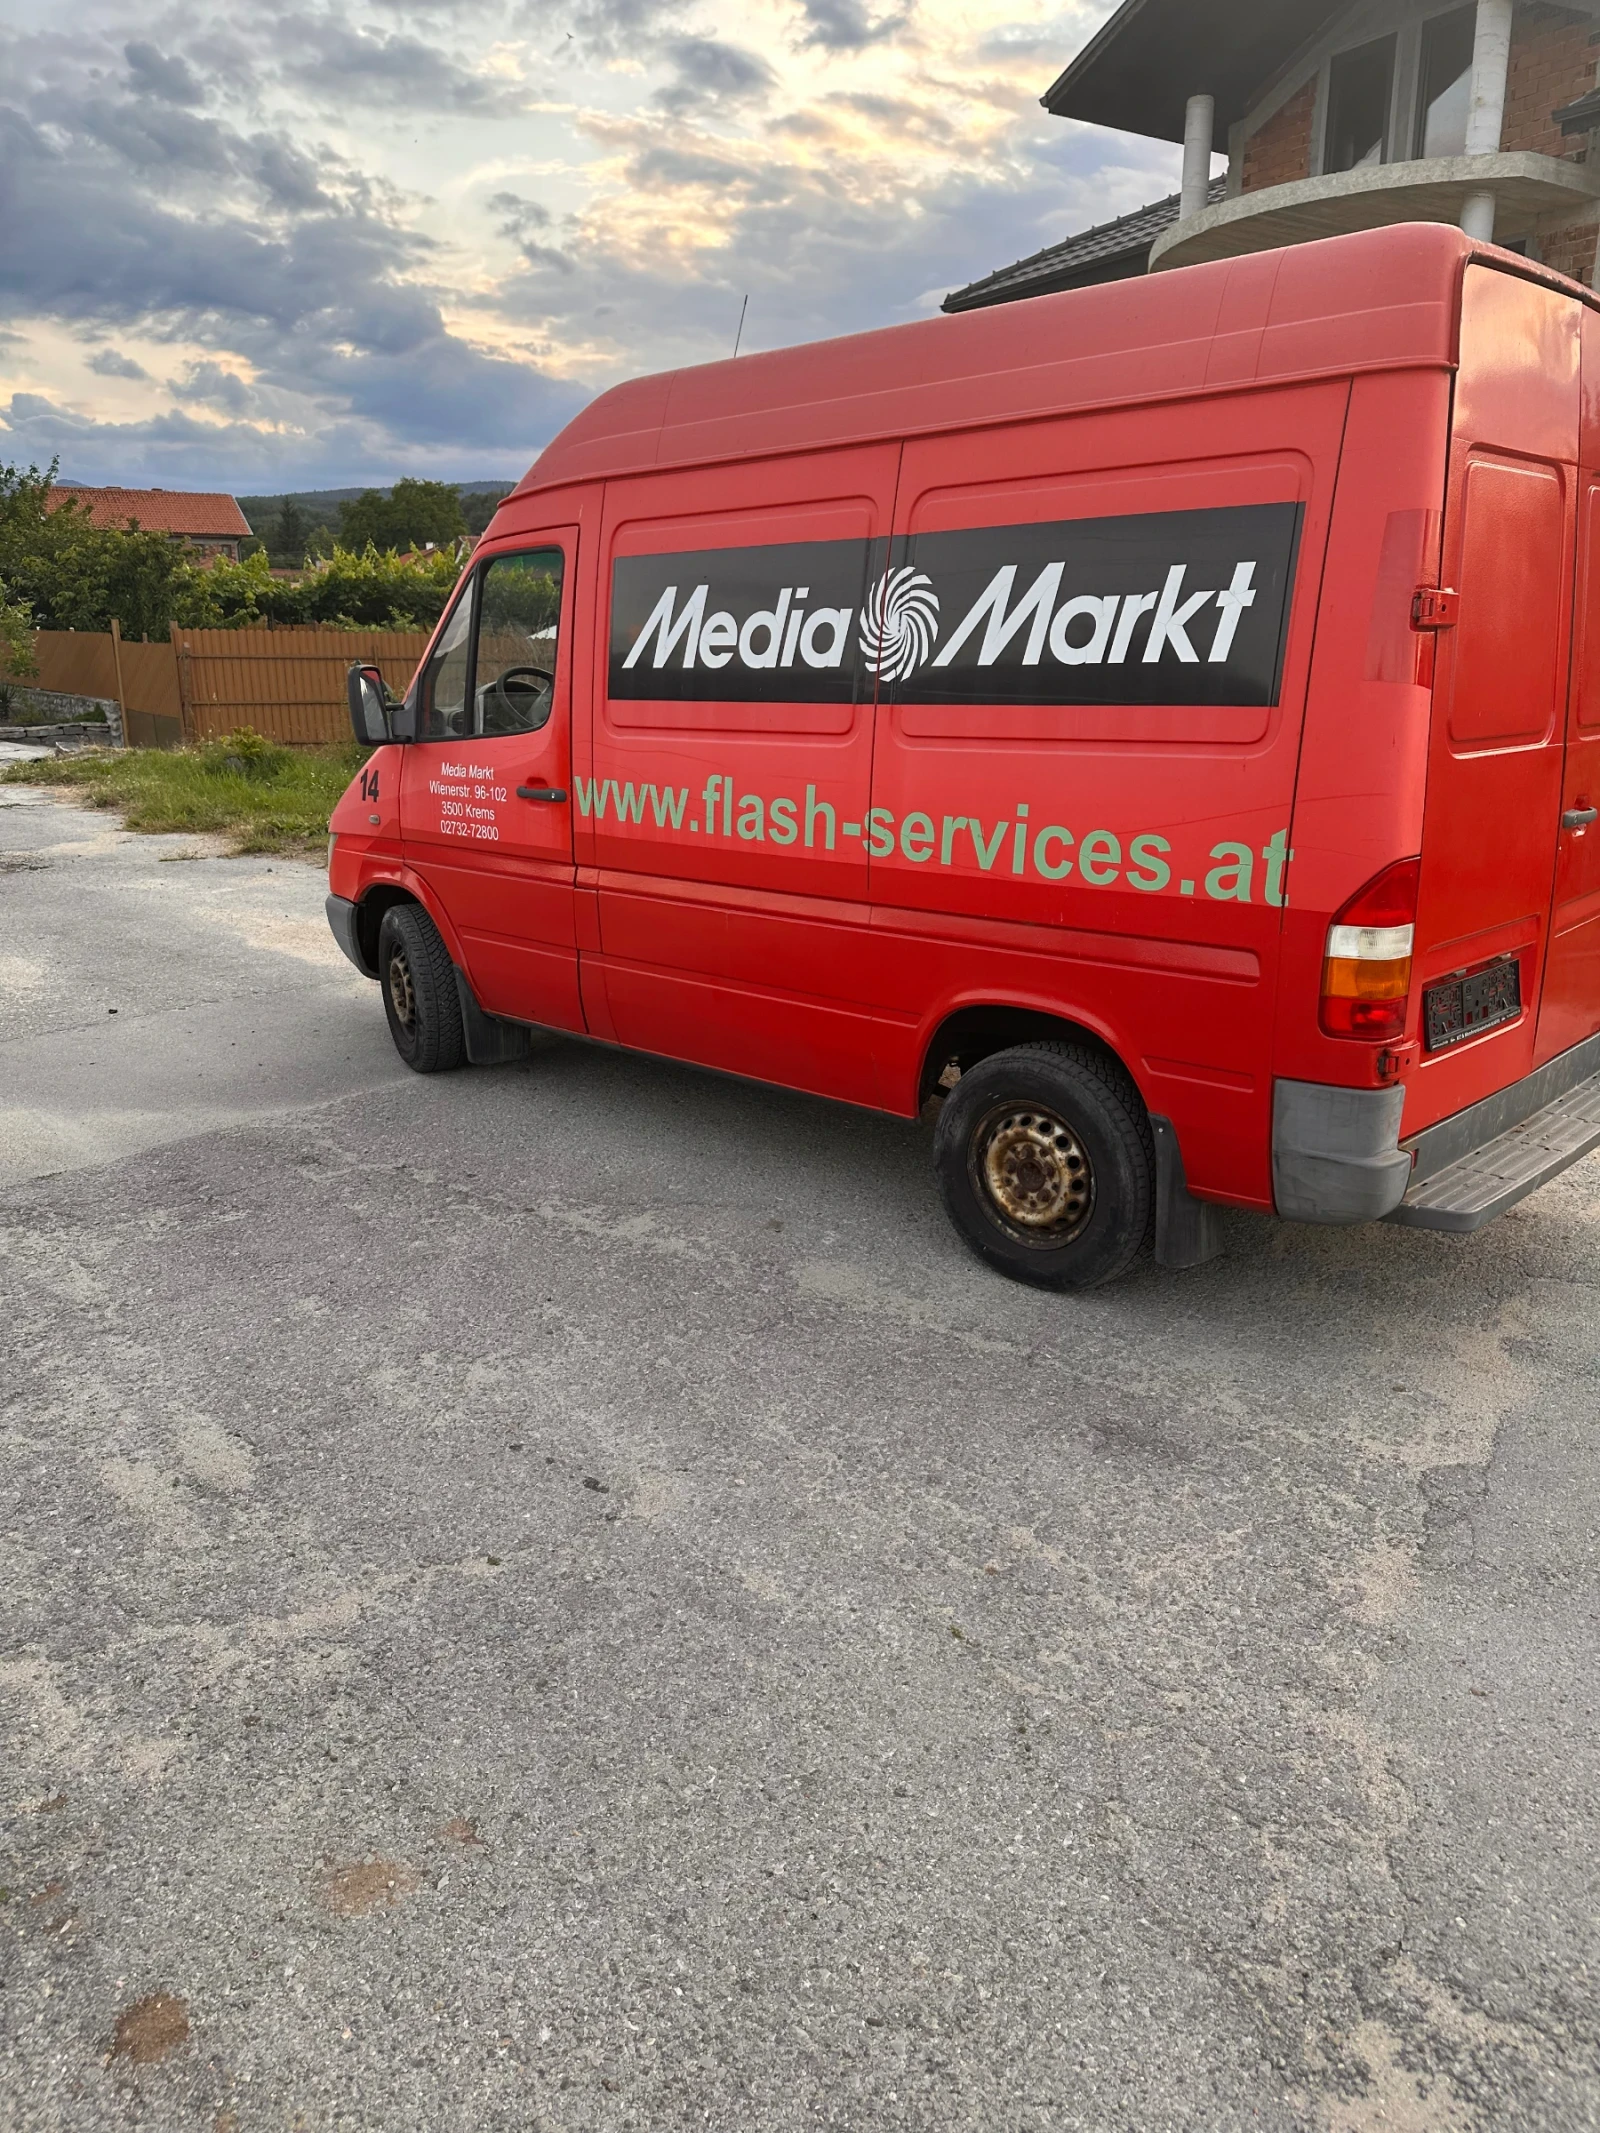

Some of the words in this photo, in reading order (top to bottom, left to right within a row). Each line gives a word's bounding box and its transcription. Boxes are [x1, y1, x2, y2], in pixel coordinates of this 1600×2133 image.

[622, 584, 853, 669] Media
[932, 561, 1257, 666] Markt
[441, 762, 467, 777] Media
[469, 765, 495, 780] Markt
[360, 769, 380, 802] 14
[429, 780, 471, 799] Wienerstr.
[475, 784, 507, 802] 96-102
[441, 801, 463, 816] 3500
[466, 804, 495, 820] Krems
[440, 819, 499, 840] 02732-72800
[574, 774, 1295, 907] www.flash-services.at
